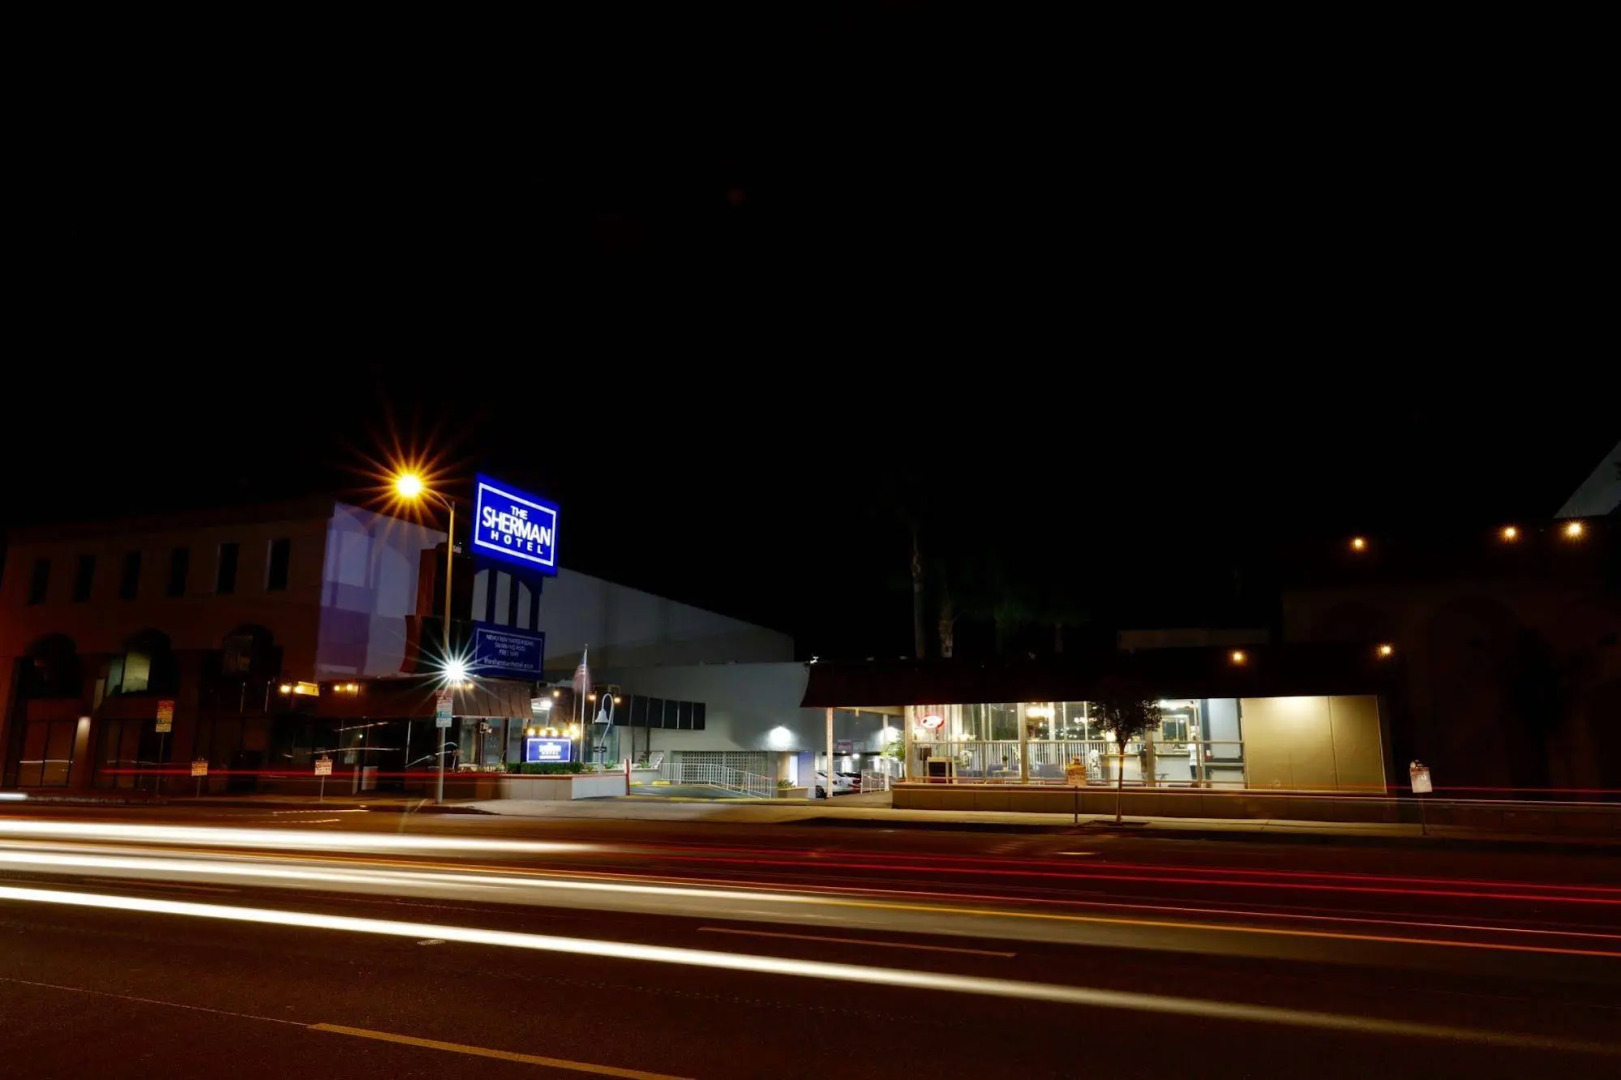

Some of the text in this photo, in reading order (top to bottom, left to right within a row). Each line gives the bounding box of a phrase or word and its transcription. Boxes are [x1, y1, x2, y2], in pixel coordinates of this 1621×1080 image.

[510, 505, 528, 520] THE
[482, 506, 551, 547] SHERMAN
[490, 530, 543, 554] HOTEL
